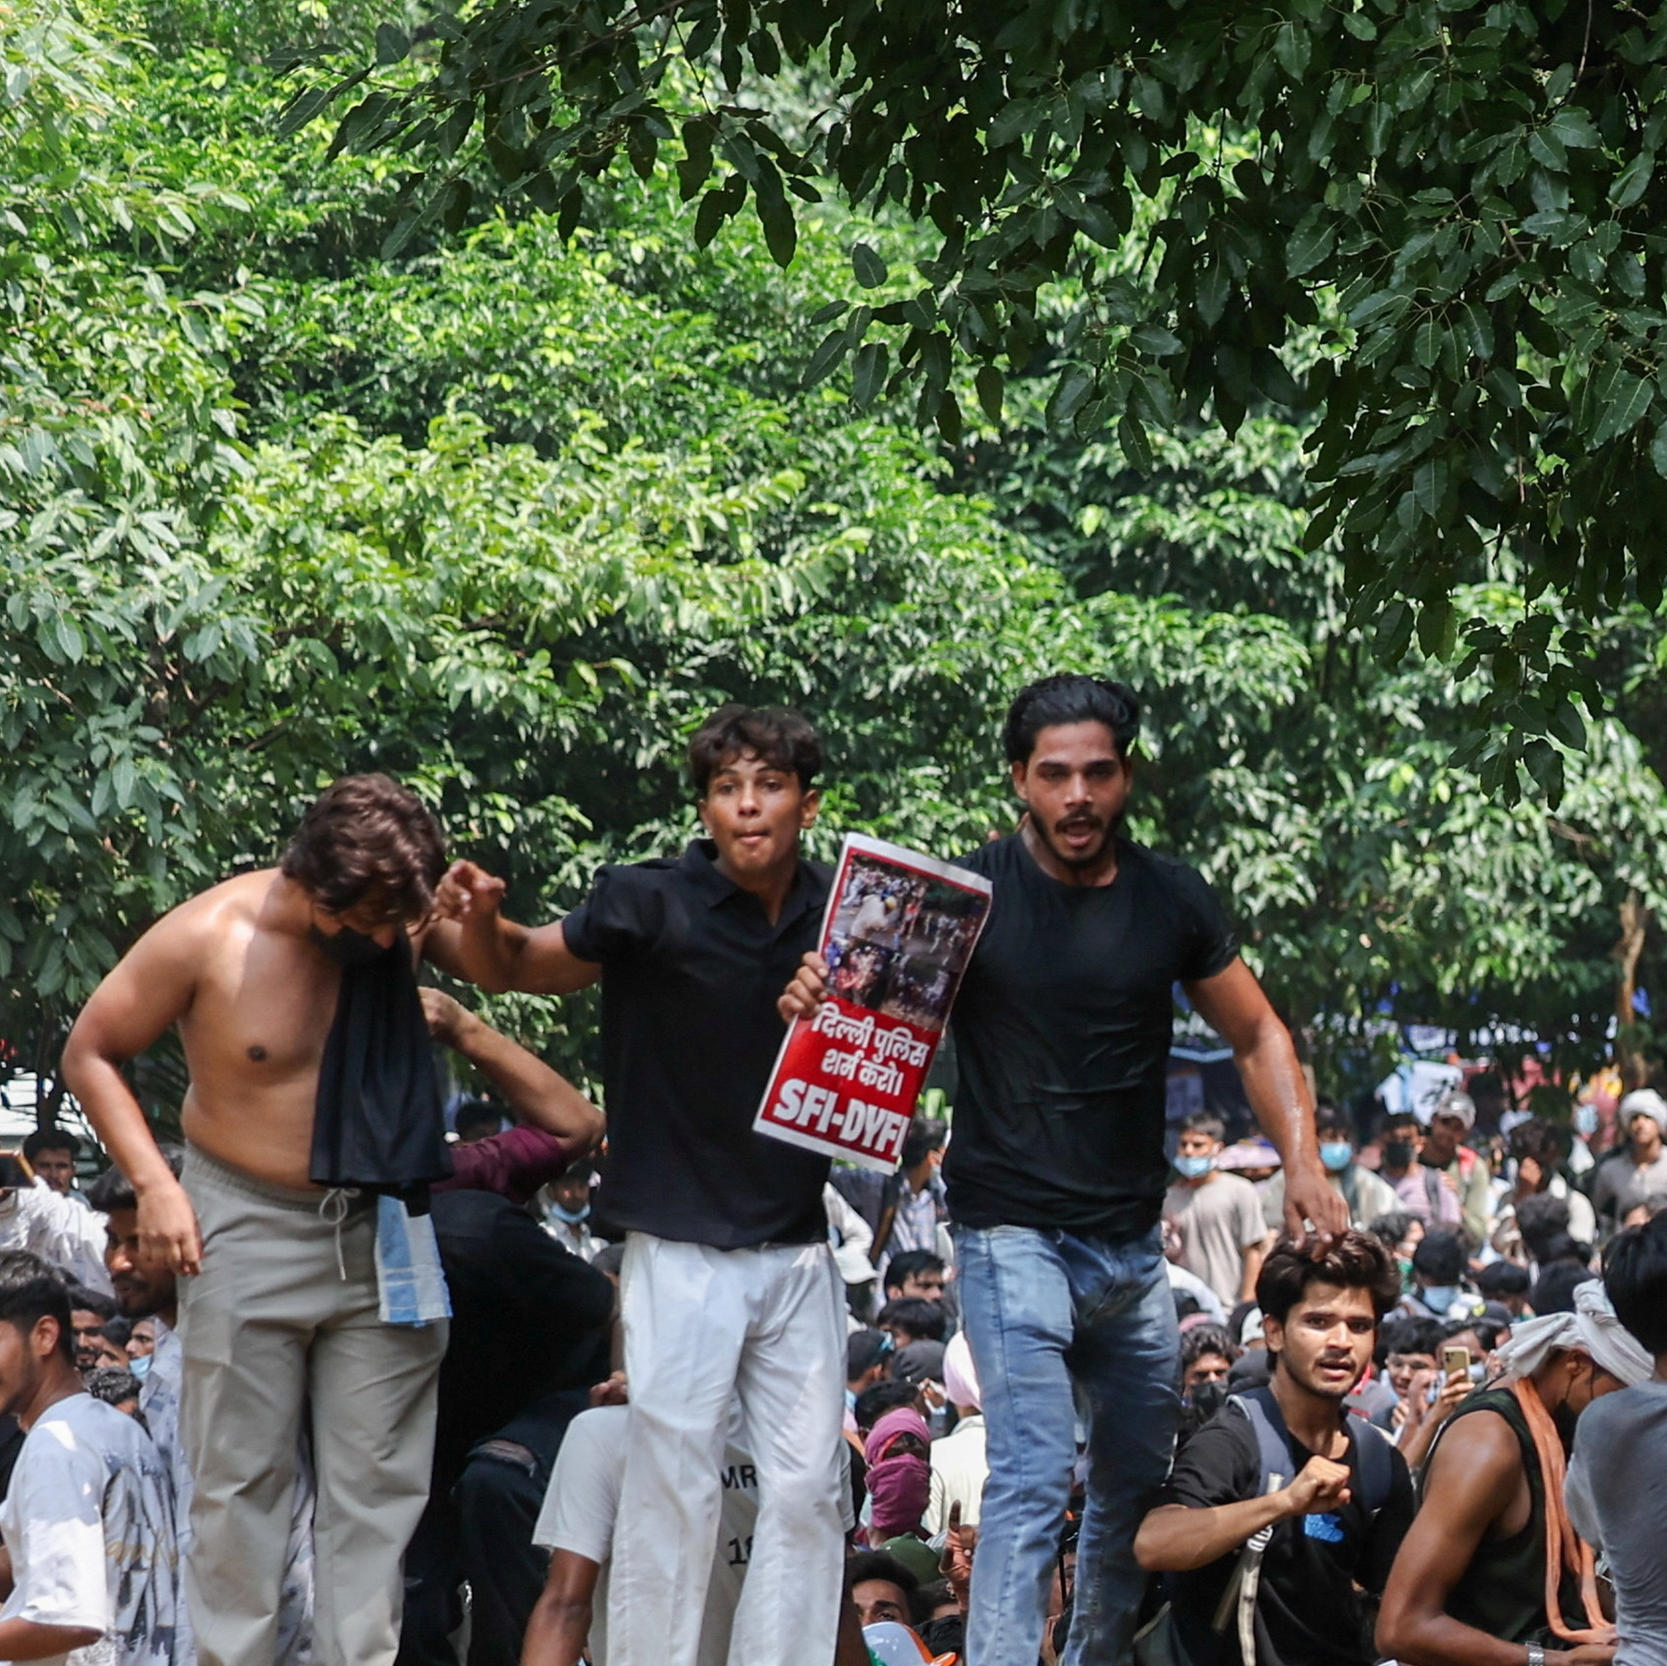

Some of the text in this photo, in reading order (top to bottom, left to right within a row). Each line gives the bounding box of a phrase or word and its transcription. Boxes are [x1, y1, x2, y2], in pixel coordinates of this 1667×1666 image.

[811, 1002, 930, 1067] दिल्ली पुलिस
[821, 1048, 864, 1080] शर्म
[772, 1078, 911, 1156] SFI-DYFI
